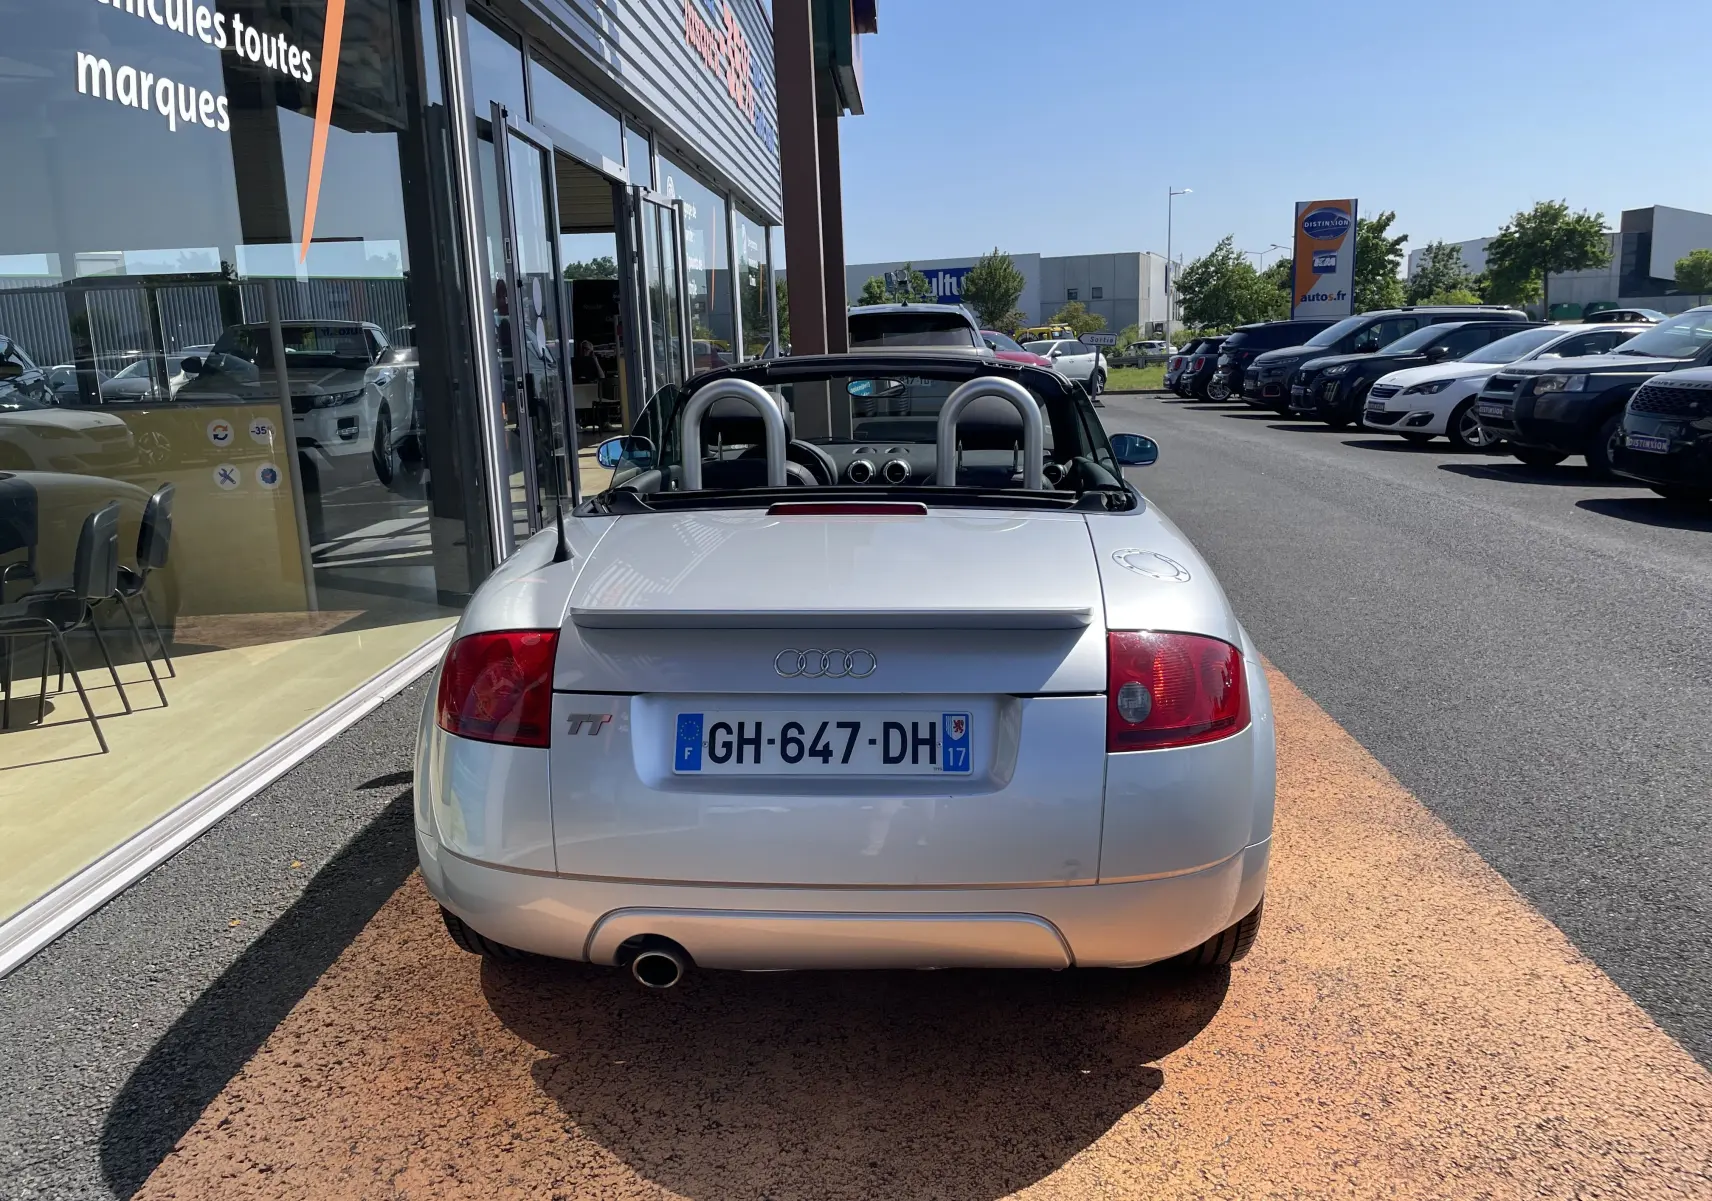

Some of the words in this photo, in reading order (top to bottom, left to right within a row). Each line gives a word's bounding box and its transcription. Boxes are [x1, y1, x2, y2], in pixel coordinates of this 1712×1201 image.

[232, 13, 313, 83] toutes
[76, 51, 230, 132] marques
[1304, 218, 1348, 228] DISTINXION
[1300, 290, 1347, 303] autos.fr
[1089, 336, 1114, 344] Sortie
[567, 713, 613, 736] TT
[708, 721, 937, 765] GH-647-DH
[684, 747, 693, 760] F
[948, 747, 966, 767] 17
